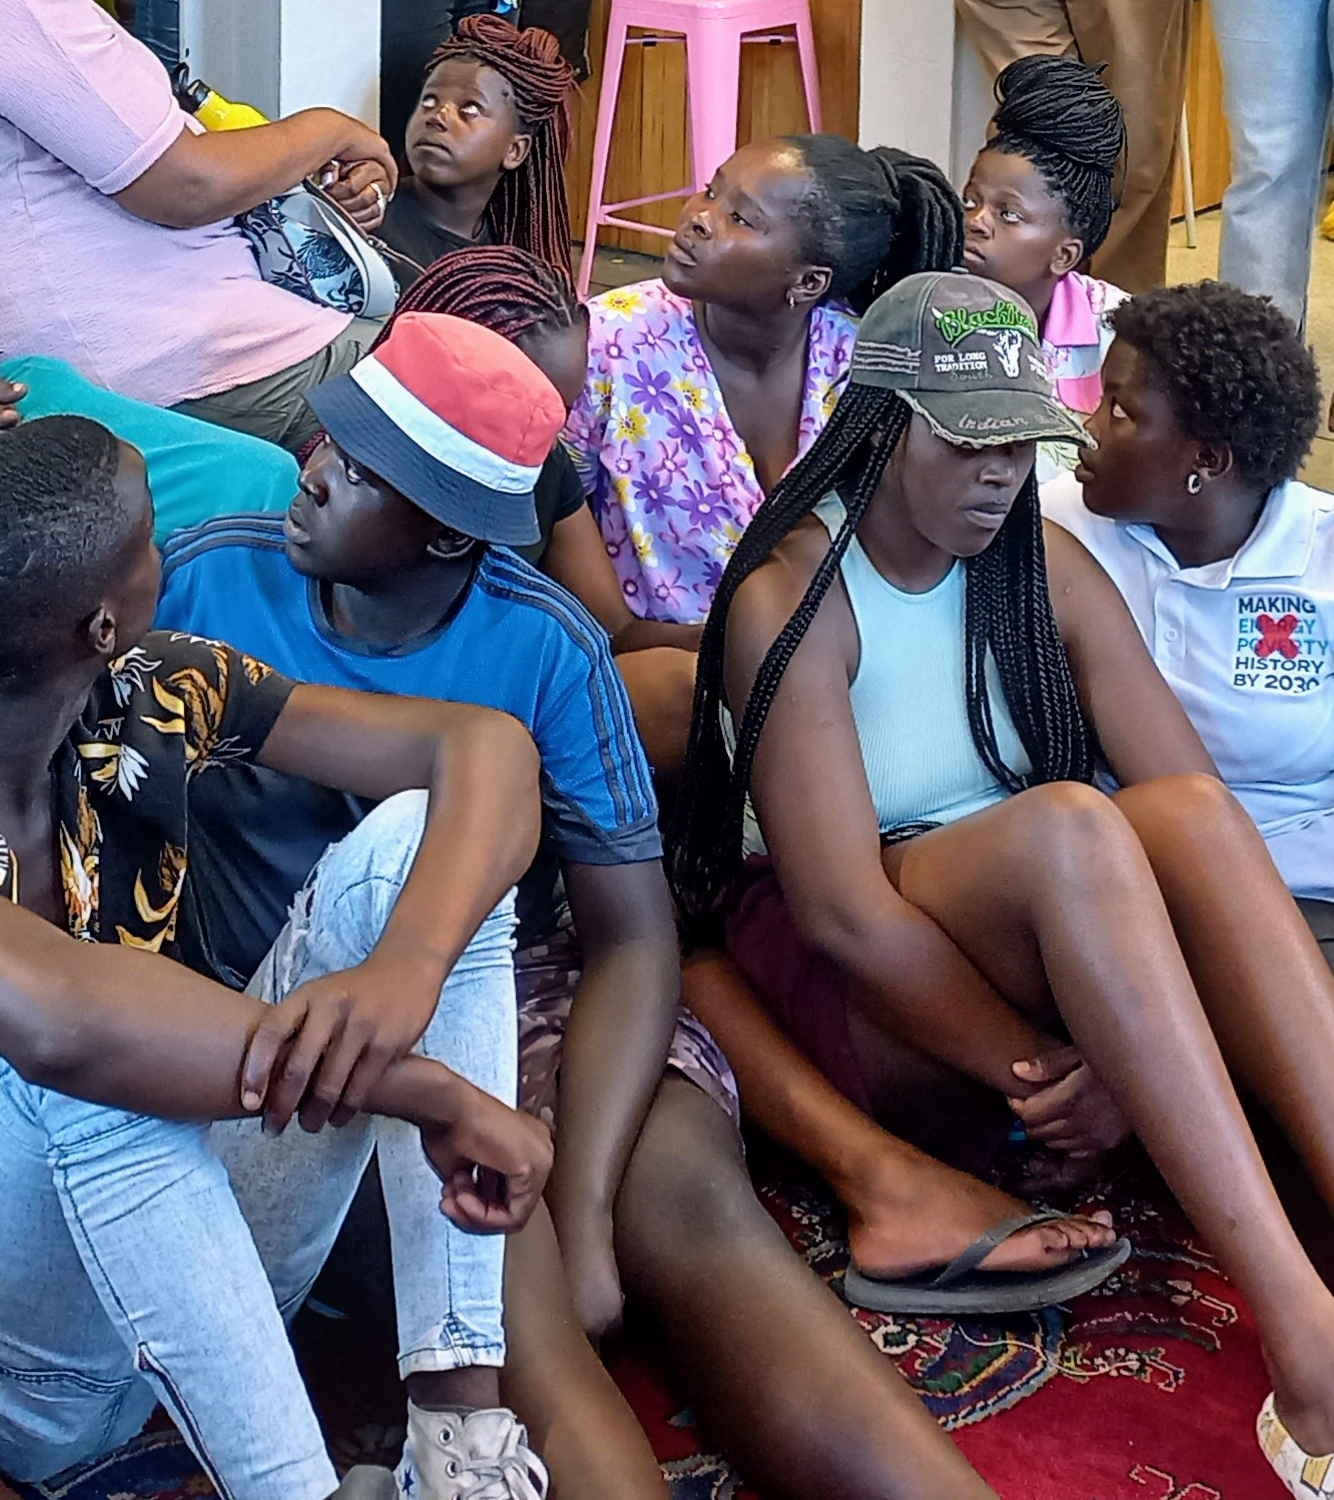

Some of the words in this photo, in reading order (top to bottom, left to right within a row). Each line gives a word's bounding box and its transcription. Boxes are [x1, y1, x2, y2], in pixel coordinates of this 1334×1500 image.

[958, 352, 987, 362] LONG
[934, 361, 988, 373] TRADITION
[1238, 596, 1317, 614] MAKING
[1235, 656, 1325, 674] HISTORY
[1233, 673, 1260, 688] BY
